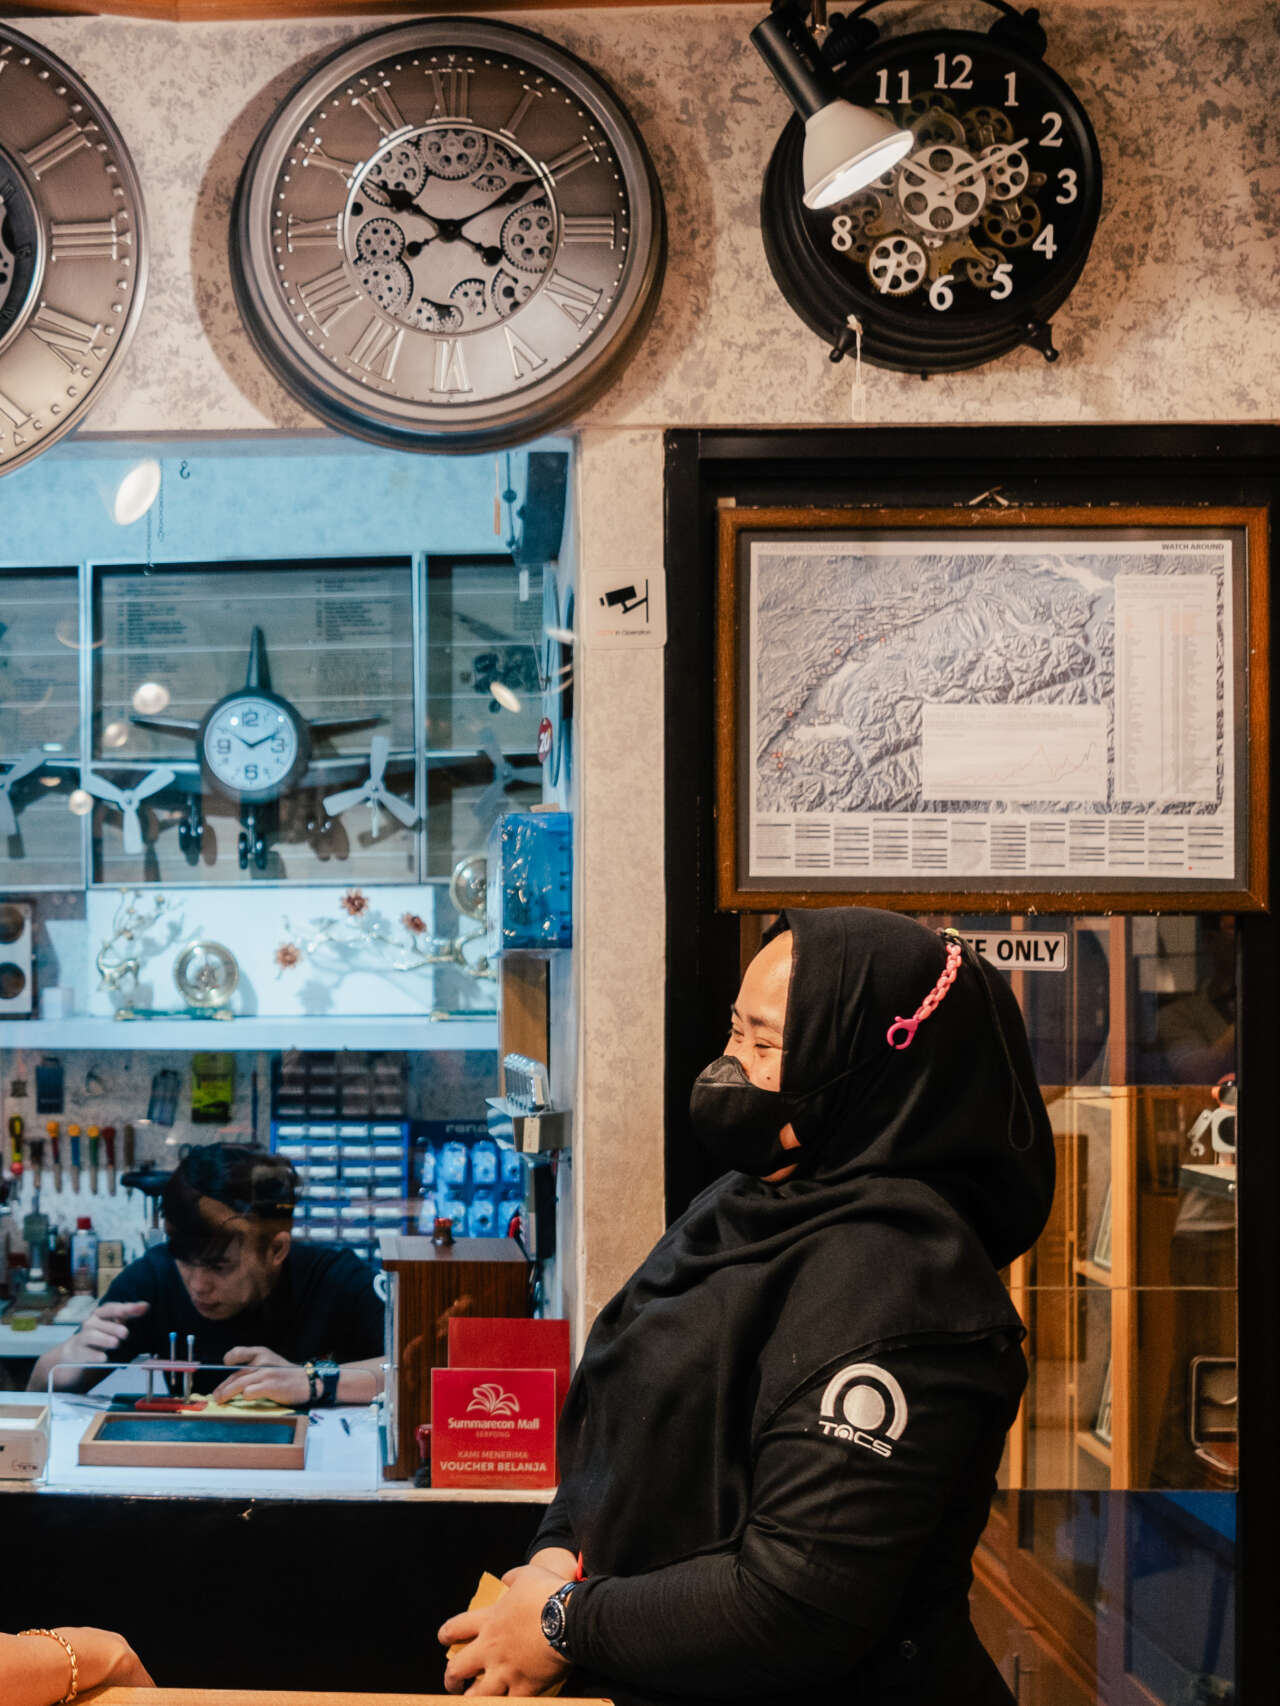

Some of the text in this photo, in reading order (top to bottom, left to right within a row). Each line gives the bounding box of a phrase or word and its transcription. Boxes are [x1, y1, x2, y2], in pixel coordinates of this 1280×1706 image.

[875, 69, 912, 104] 11
[933, 53, 973, 89] 12
[1004, 71, 1019, 106] 1
[1039, 112, 1063, 147] 2
[1056, 168, 1078, 204] 3
[831, 215, 853, 251] 8
[1032, 224, 1057, 260] 4
[929, 275, 954, 311] 6
[990, 264, 1013, 300] 5
[1161, 543, 1225, 551] WATCH AROUND
[242, 712, 259, 728] 12
[217, 739, 231, 754] 9
[271, 739, 285, 753] 3
[244, 764, 258, 780] 6
[996, 939, 1060, 962] ONLY
[447, 1417, 540, 1430] Summarecon Mall
[440, 1461, 547, 1472] VOUCHER BELANJA
